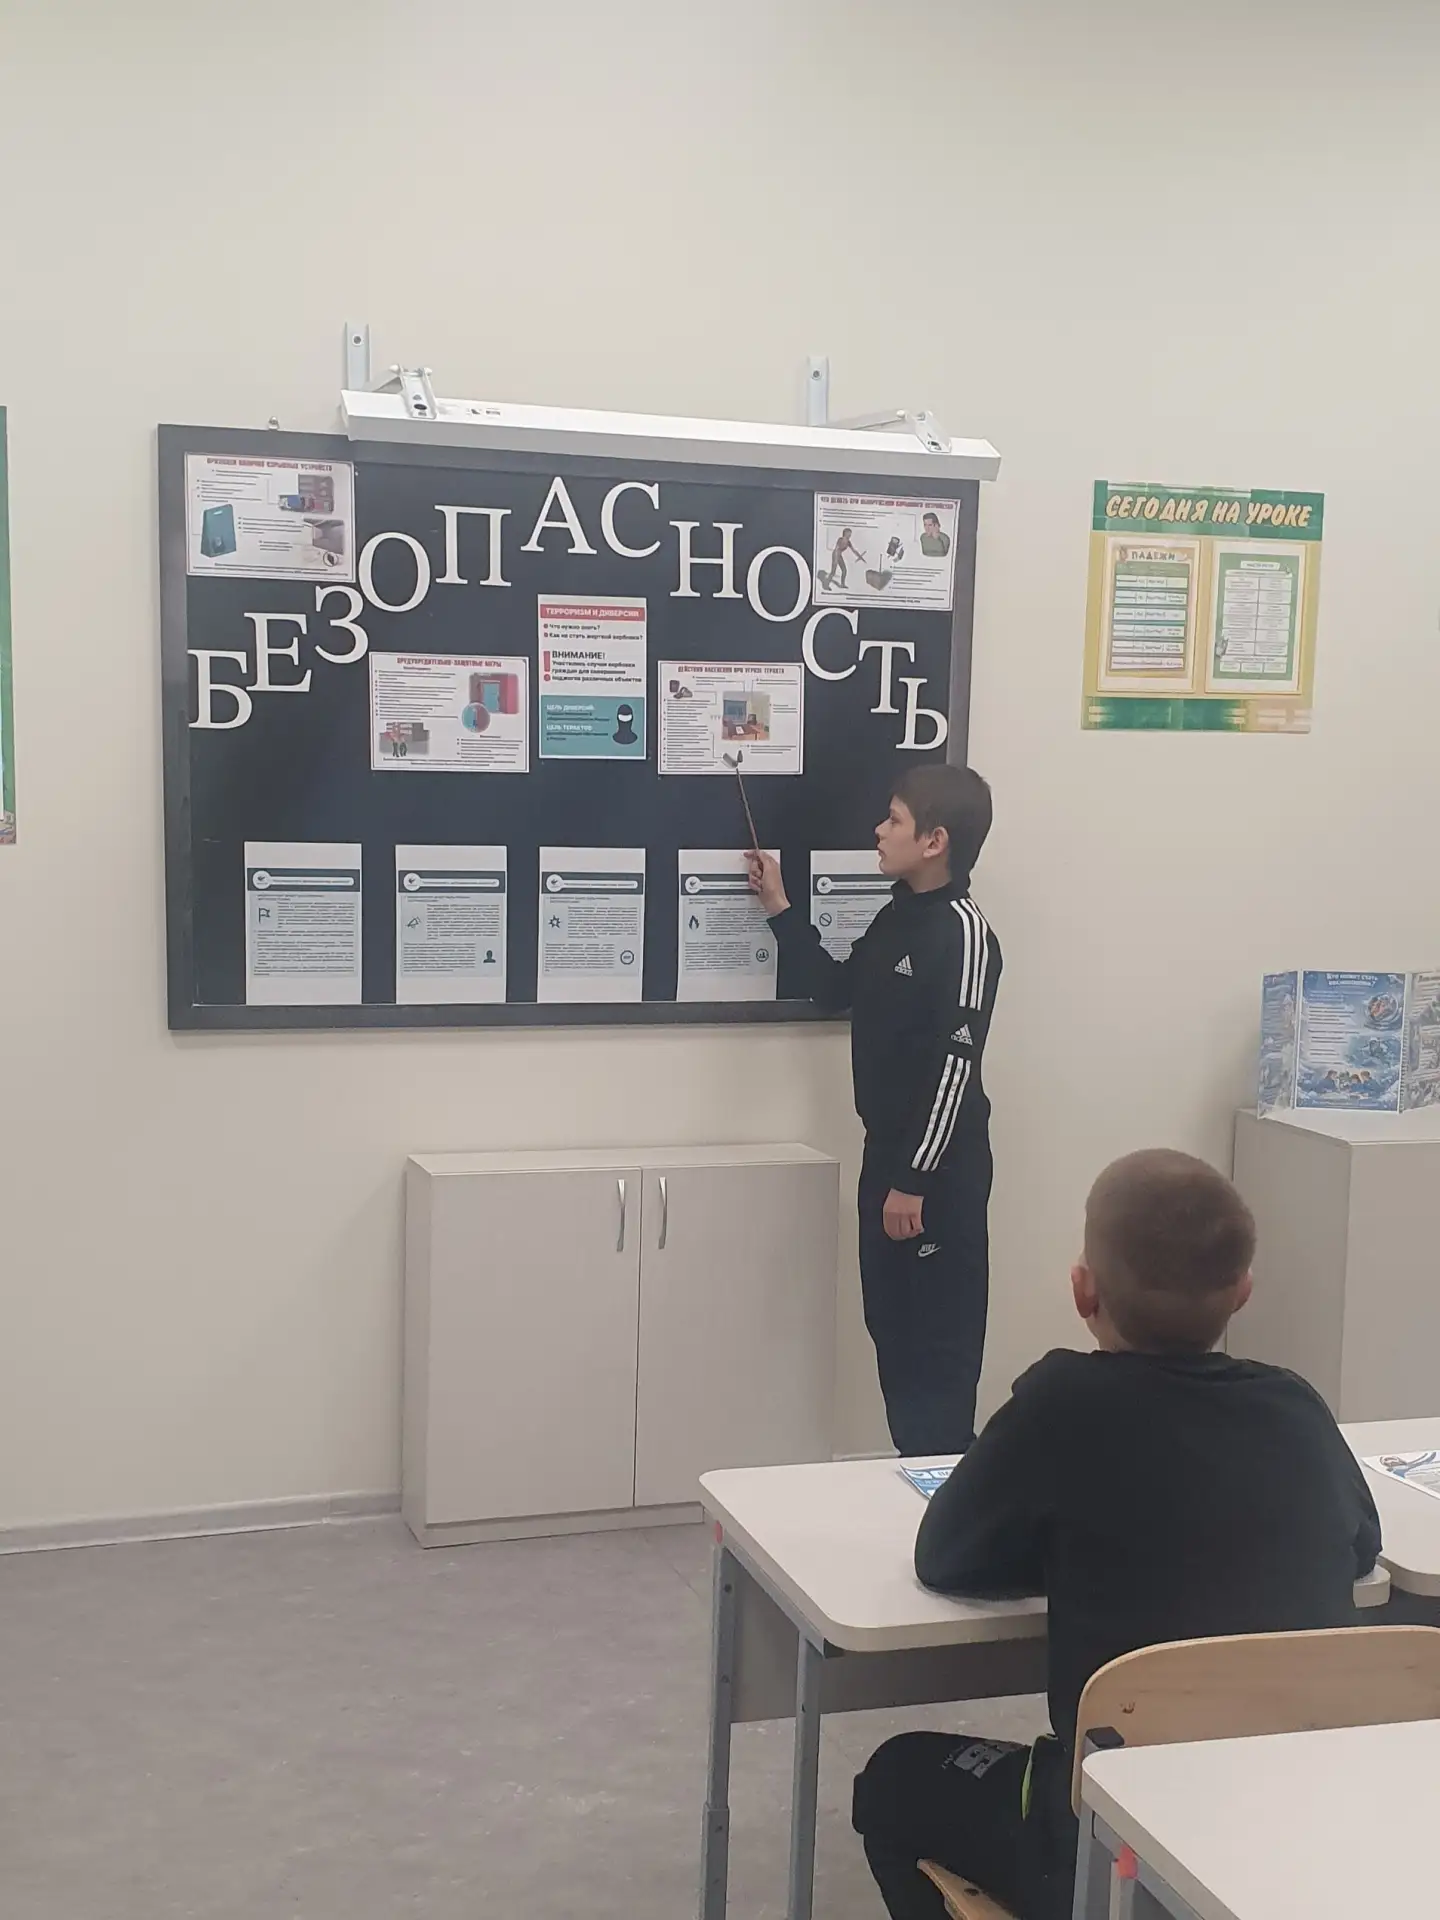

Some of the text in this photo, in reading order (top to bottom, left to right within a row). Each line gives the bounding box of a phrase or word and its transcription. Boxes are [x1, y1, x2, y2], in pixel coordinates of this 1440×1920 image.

[1106, 494, 1313, 527] СЕГОДНЯ НА УРОКЕ
[1131, 551, 1175, 561] ПАДЕЖИ
[188, 476, 949, 751] БЕЗОПАСНОСТЬ
[545, 607, 639, 618] ТЕРРОРИЗМ И ДИВЕРСИИ
[552, 650, 606, 660] ВНИМАНИЕ!
